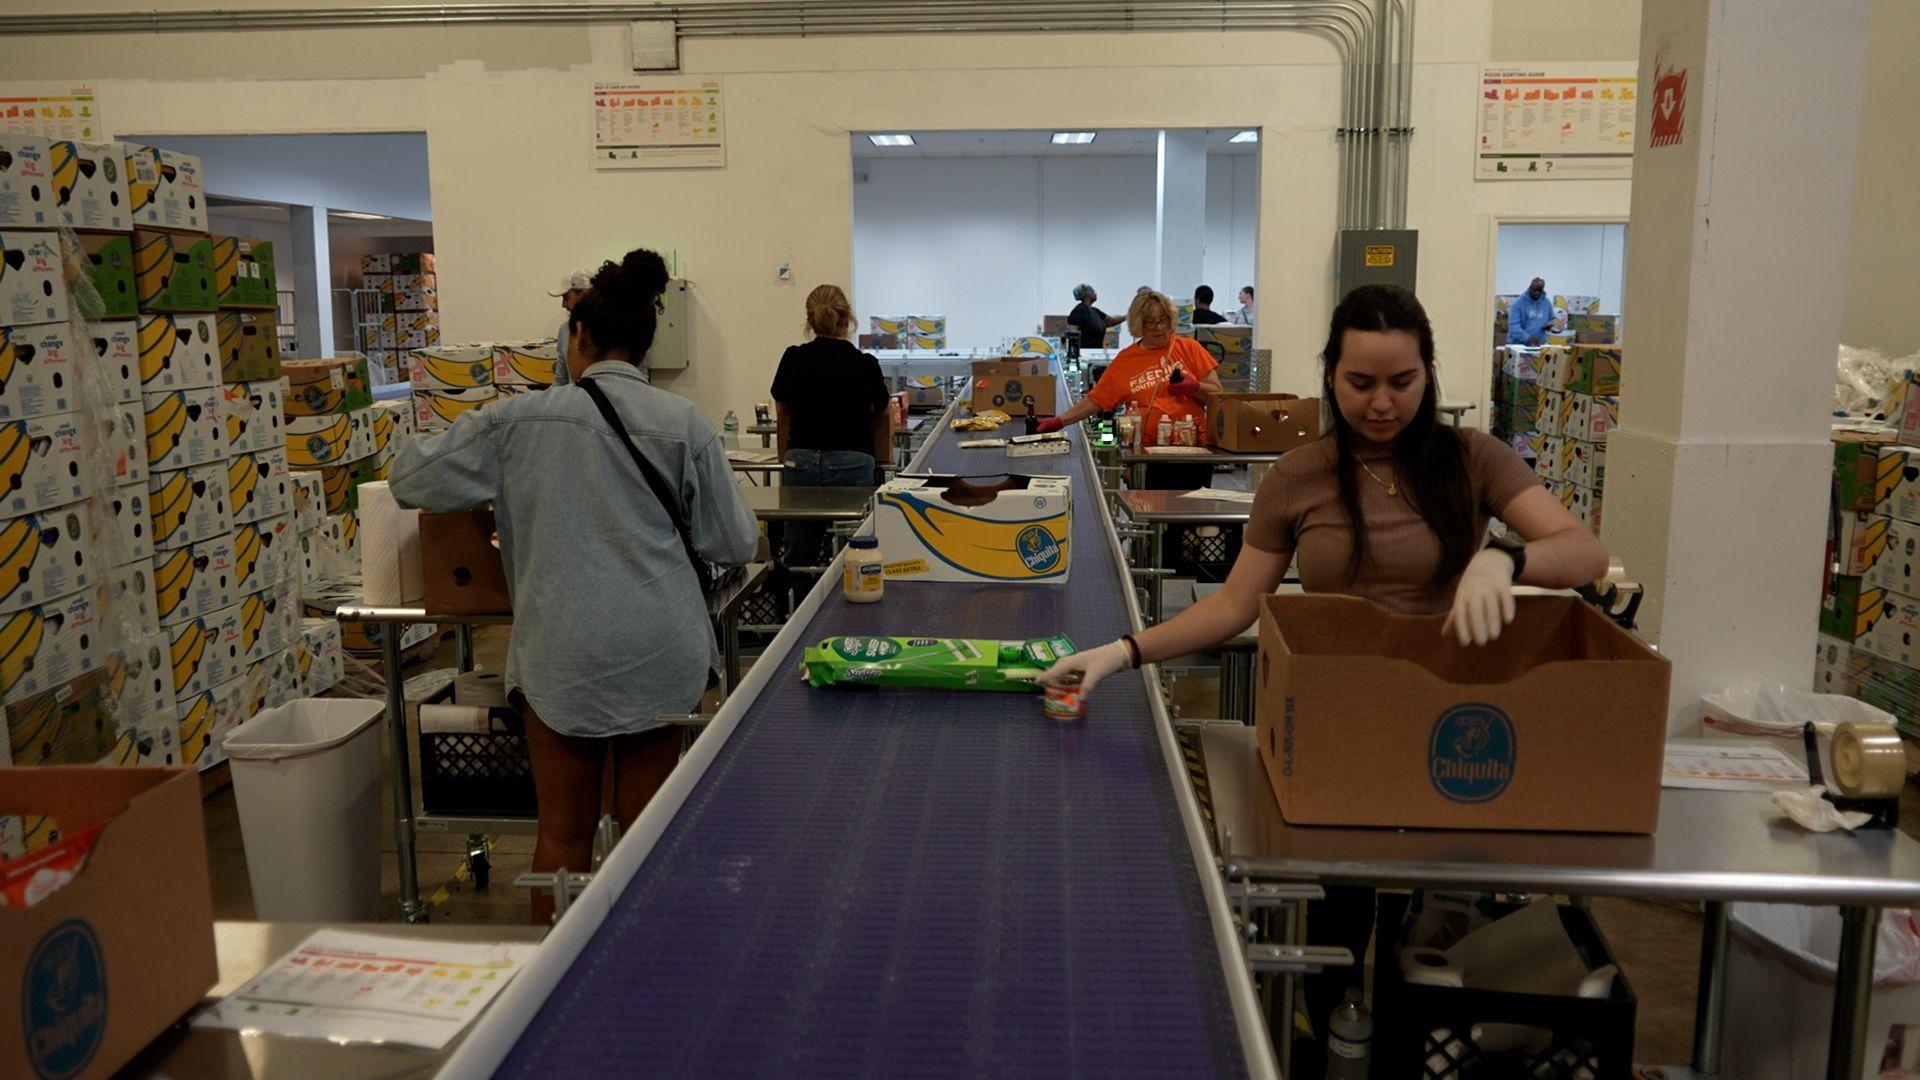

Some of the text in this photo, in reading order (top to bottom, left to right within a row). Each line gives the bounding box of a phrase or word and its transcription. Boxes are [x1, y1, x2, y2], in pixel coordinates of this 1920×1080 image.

[40, 339, 63, 349] change
[1129, 361, 1184, 388] FEEDING
[1131, 380, 1157, 394] SOUTH
[1024, 543, 1060, 568] Chiquita
[903, 565, 921, 573] EXTRA
[847, 667, 881, 680] Swiffer
[1432, 757, 1511, 785] Chiquita
[31, 992, 106, 1063] Chiquita
